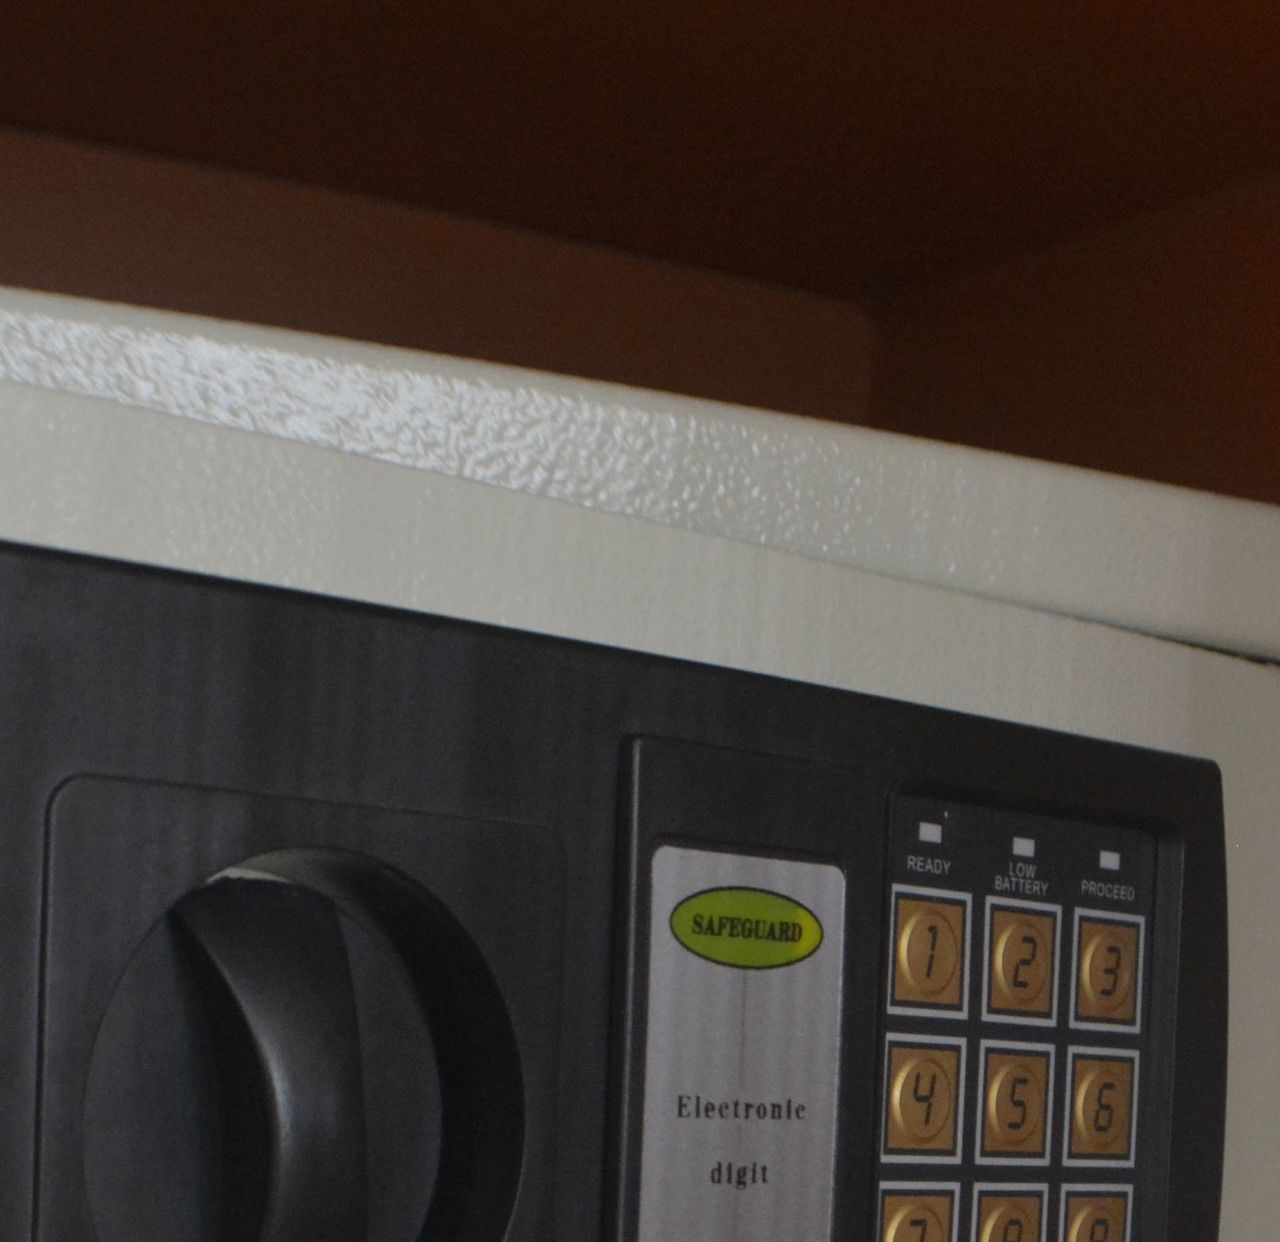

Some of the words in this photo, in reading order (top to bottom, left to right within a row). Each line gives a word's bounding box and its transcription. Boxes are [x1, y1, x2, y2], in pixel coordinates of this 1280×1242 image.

[906, 855, 952, 876] READY
[1008, 862, 1038, 880] LOW
[994, 875, 1049, 897] BATTERY
[1080, 880, 1136, 901] PROCEED
[691, 914, 803, 943] SAFEGUARD
[926, 924, 939, 979] 1
[1012, 936, 1038, 988] 2
[1099, 946, 1121, 996] 3
[676, 1094, 807, 1121] Electronic
[913, 1072, 937, 1126] 4
[1007, 1077, 1029, 1130] 5
[1094, 1082, 1116, 1133] 6
[709, 1162, 770, 1190] digit
